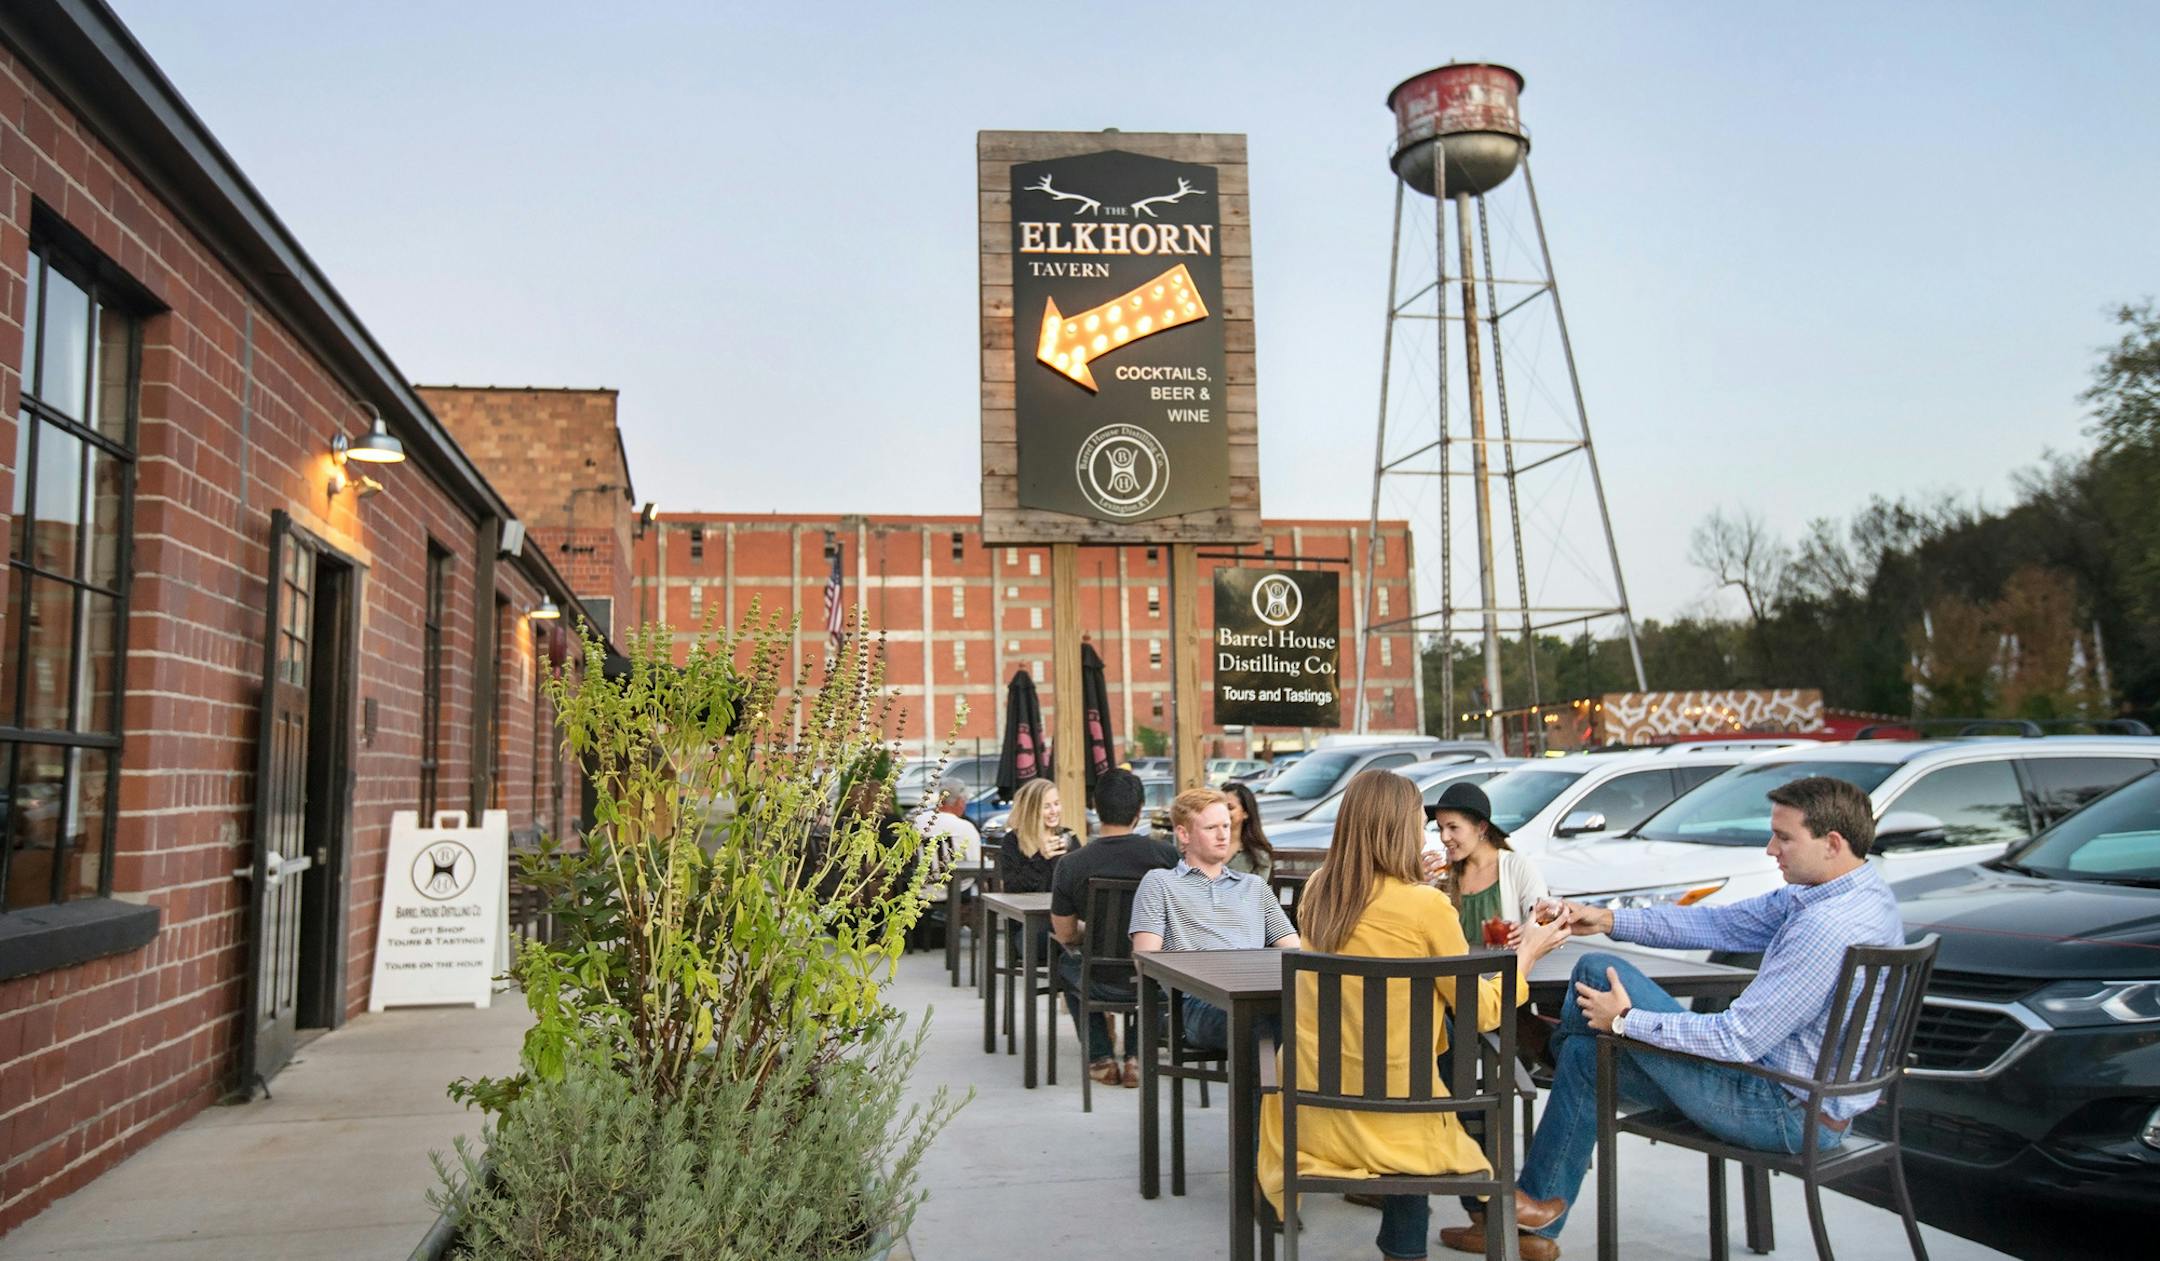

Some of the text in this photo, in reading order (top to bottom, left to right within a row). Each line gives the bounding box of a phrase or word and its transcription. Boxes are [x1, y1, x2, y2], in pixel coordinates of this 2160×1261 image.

[1104, 205, 1128, 216] THE
[1019, 221, 1213, 256] ELKHORN
[1028, 261, 1111, 278] TAVERN
[1115, 365, 1212, 382] COCKTAILS,
[1150, 386, 1211, 401] BEER &
[1167, 408, 1211, 423] WINE
[1079, 443, 1096, 470] Barrel
[1091, 428, 1120, 446] House
[1121, 427, 1158, 454] Distilling
[1118, 451, 1128, 462] B
[1119, 477, 1130, 489] H
[1219, 627, 1336, 650] Barrel House
[1218, 652, 1337, 677] Distilling Co.
[1222, 686, 1333, 706] Tours and Tastings
[410, 926, 465, 934] GIFT SHOP
[387, 938, 422, 946] TOURS
[385, 961, 417, 970] TOURS
[457, 960, 483, 968] HOUR
